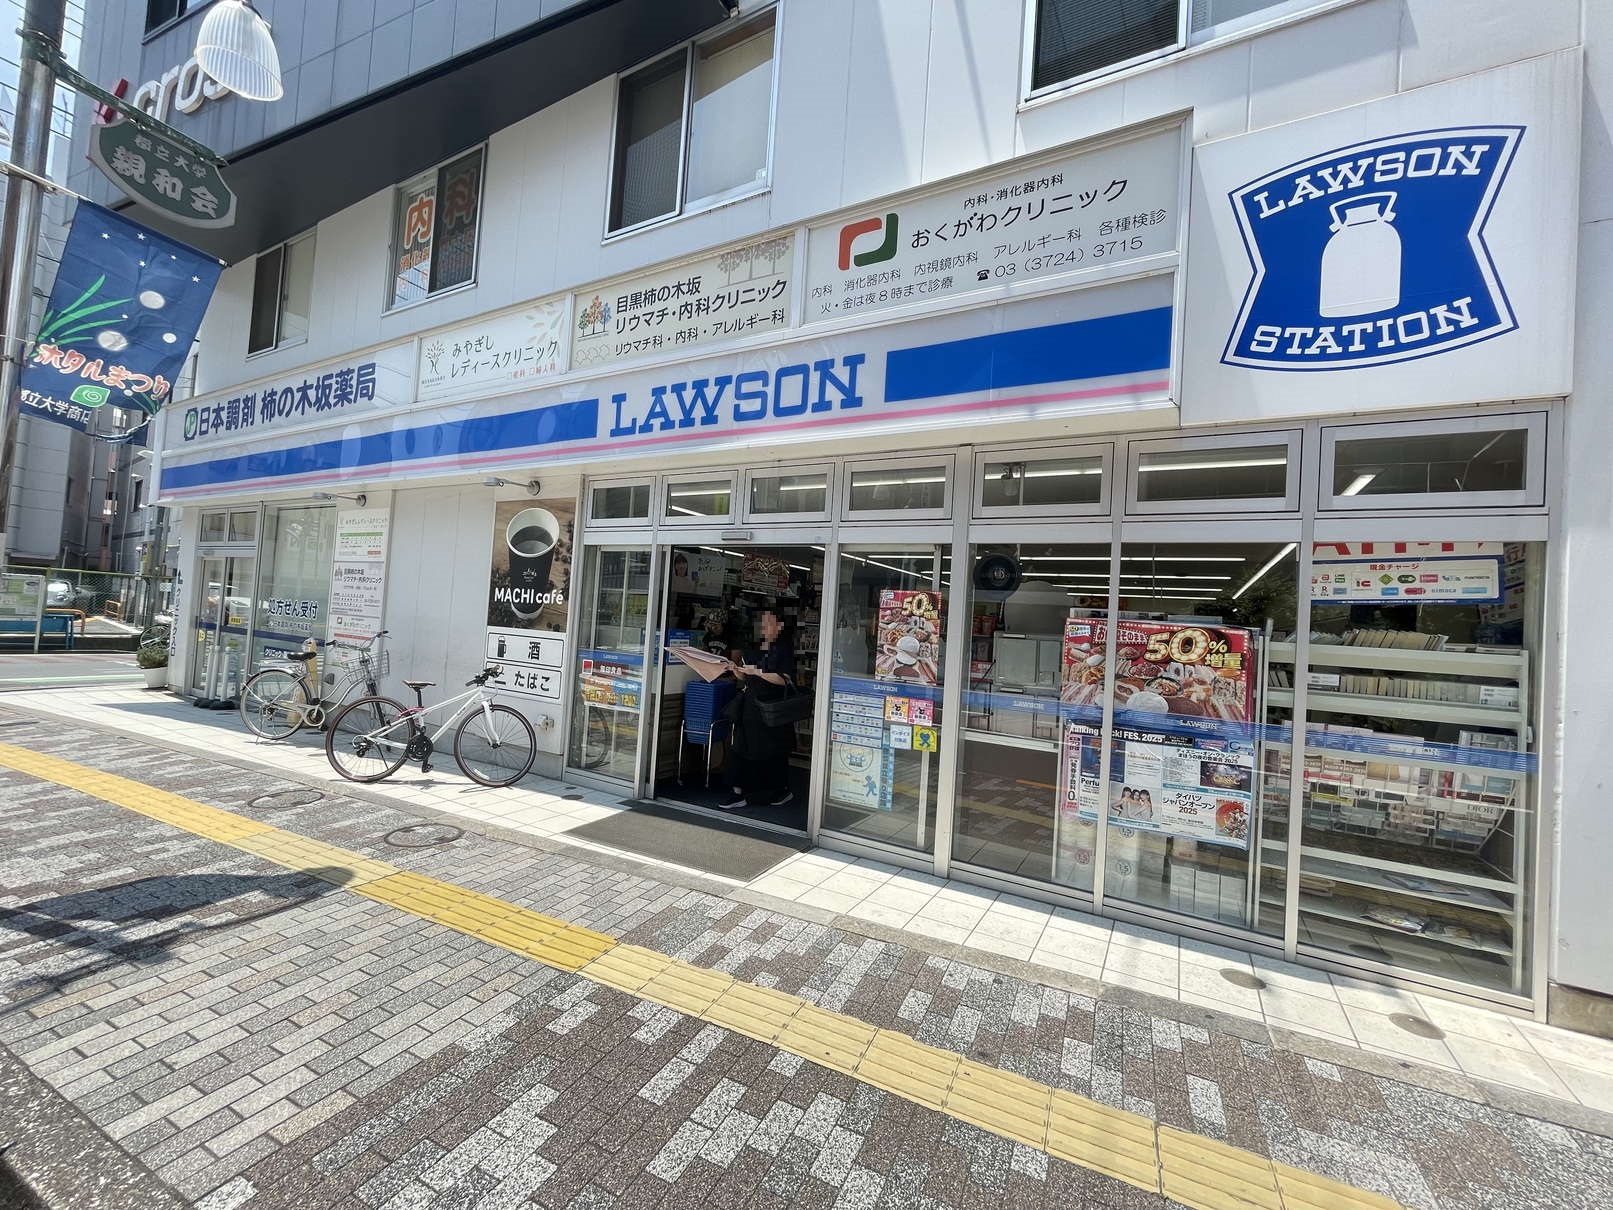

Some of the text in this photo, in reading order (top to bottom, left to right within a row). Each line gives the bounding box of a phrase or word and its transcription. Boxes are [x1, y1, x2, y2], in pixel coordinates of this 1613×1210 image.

[110, 145, 219, 219] 親和会
[963, 172, 1064, 210] 内科・消化器内科
[1253, 144, 1490, 219] LAWSON
[910, 178, 1129, 250] おくがわクリニック
[811, 207, 1167, 300] 内科 消化器内科 内視鏡内科 アレルギー科 各種検診
[615, 279, 788, 335] リウマチ・内科クリニック
[616, 275, 702, 315] 目黒柿の木坂
[1250, 296, 1479, 355] STATION
[450, 340, 559, 378] レディースクリニック
[452, 335, 495, 358] みやぎし
[33, 344, 171, 401] ホタルまつり
[199, 362, 377, 436] 日本調剤 柿の木坂薬局
[609, 353, 866, 438] LAWSON
[494, 587, 564, 605] MACHI café
[527, 641, 541, 661] 酒
[1144, 627, 1228, 664] 50%
[1205, 653, 1242, 670] 増量
[514, 670, 551, 692] たばこ
[1142, 733, 1166, 743] 2025
[1176, 792, 1202, 801] ダイハツ
[1178, 806, 1198, 815] 2025
